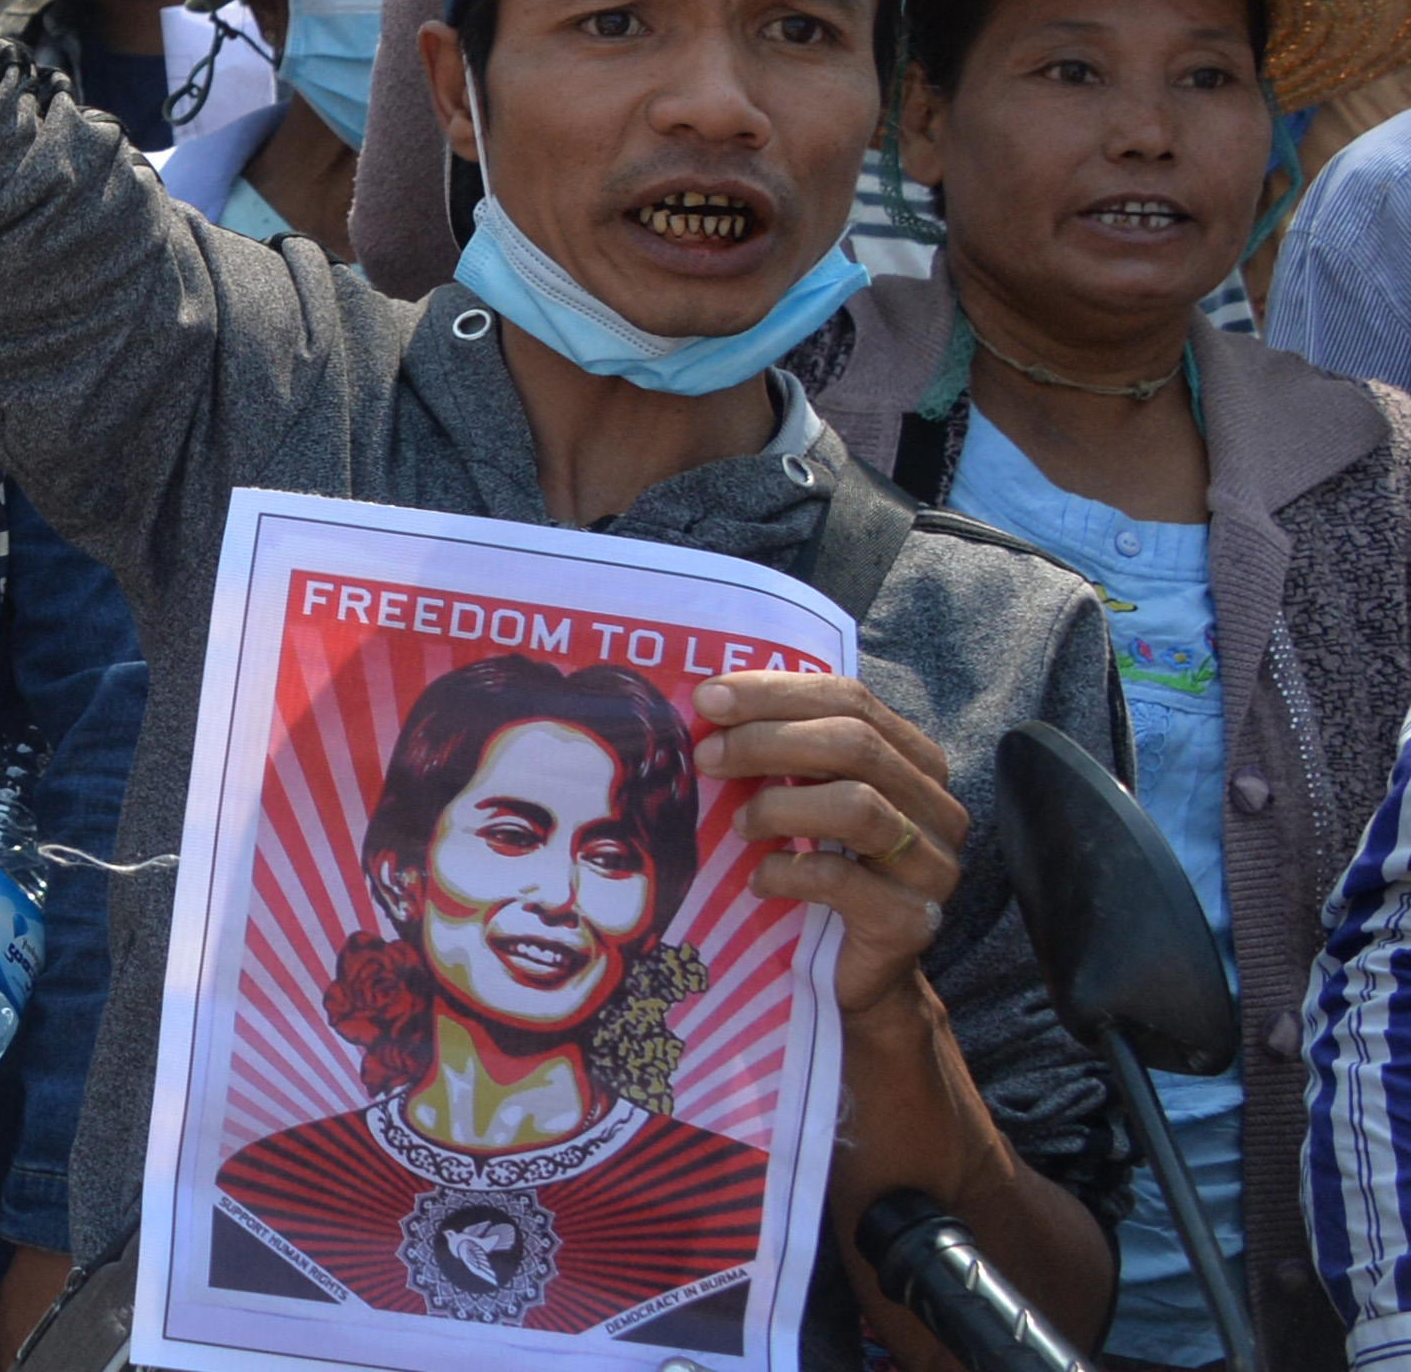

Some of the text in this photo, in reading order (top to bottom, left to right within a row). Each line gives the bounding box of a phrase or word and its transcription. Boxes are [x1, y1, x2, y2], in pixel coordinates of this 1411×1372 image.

[302, 580, 572, 654] FREEDOM
[591, 624, 664, 667] TO
[219, 1196, 350, 1301] SUPPORT HUMAN RIGHTS
[605, 1268, 748, 1335] DEMOCRACY IN BURMA
